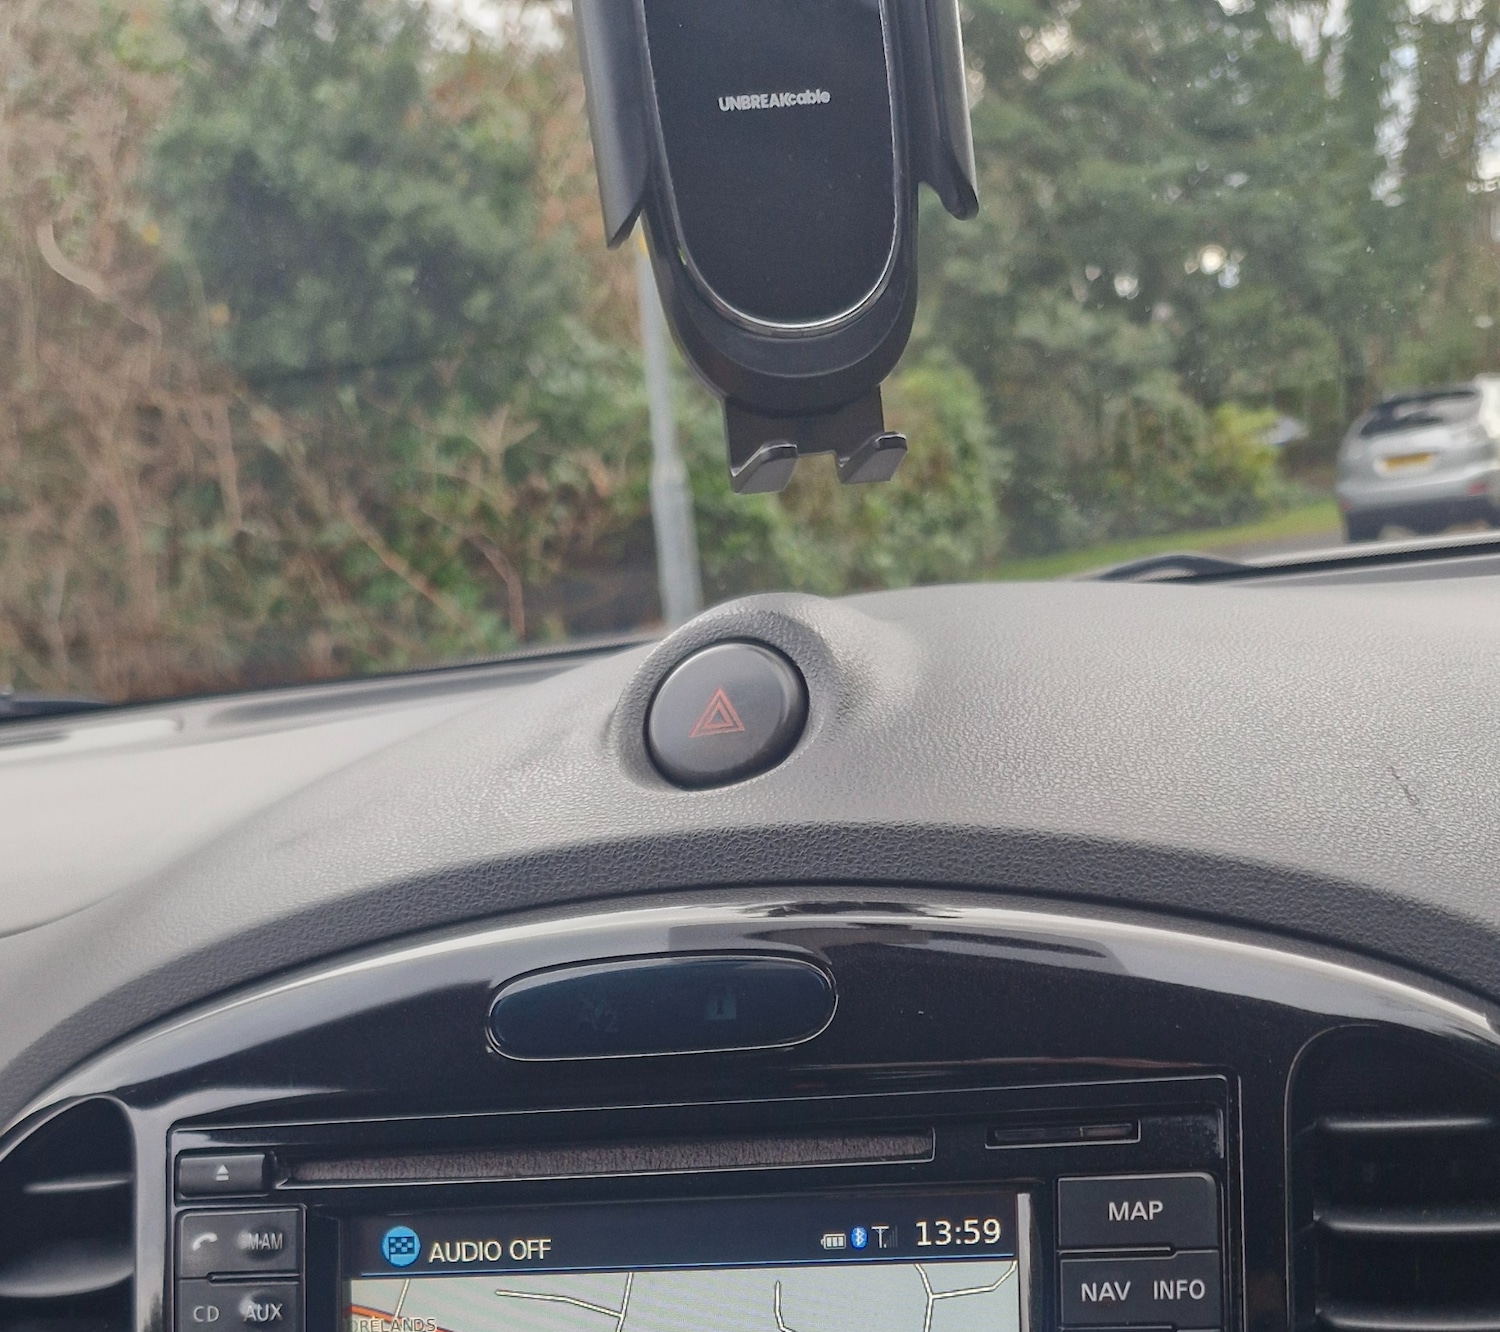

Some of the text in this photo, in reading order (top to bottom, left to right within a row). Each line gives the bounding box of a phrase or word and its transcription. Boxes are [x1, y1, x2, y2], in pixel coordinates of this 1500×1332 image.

[1108, 1200, 1164, 1221] MAP
[915, 1218, 1001, 1246] 13:59
[428, 1239, 552, 1263] AUDIO OFF
[1081, 1280, 1131, 1302] NAV
[1153, 1279, 1206, 1300] INFO
[193, 1305, 219, 1322] CD
[244, 1303, 283, 1322] AUX
